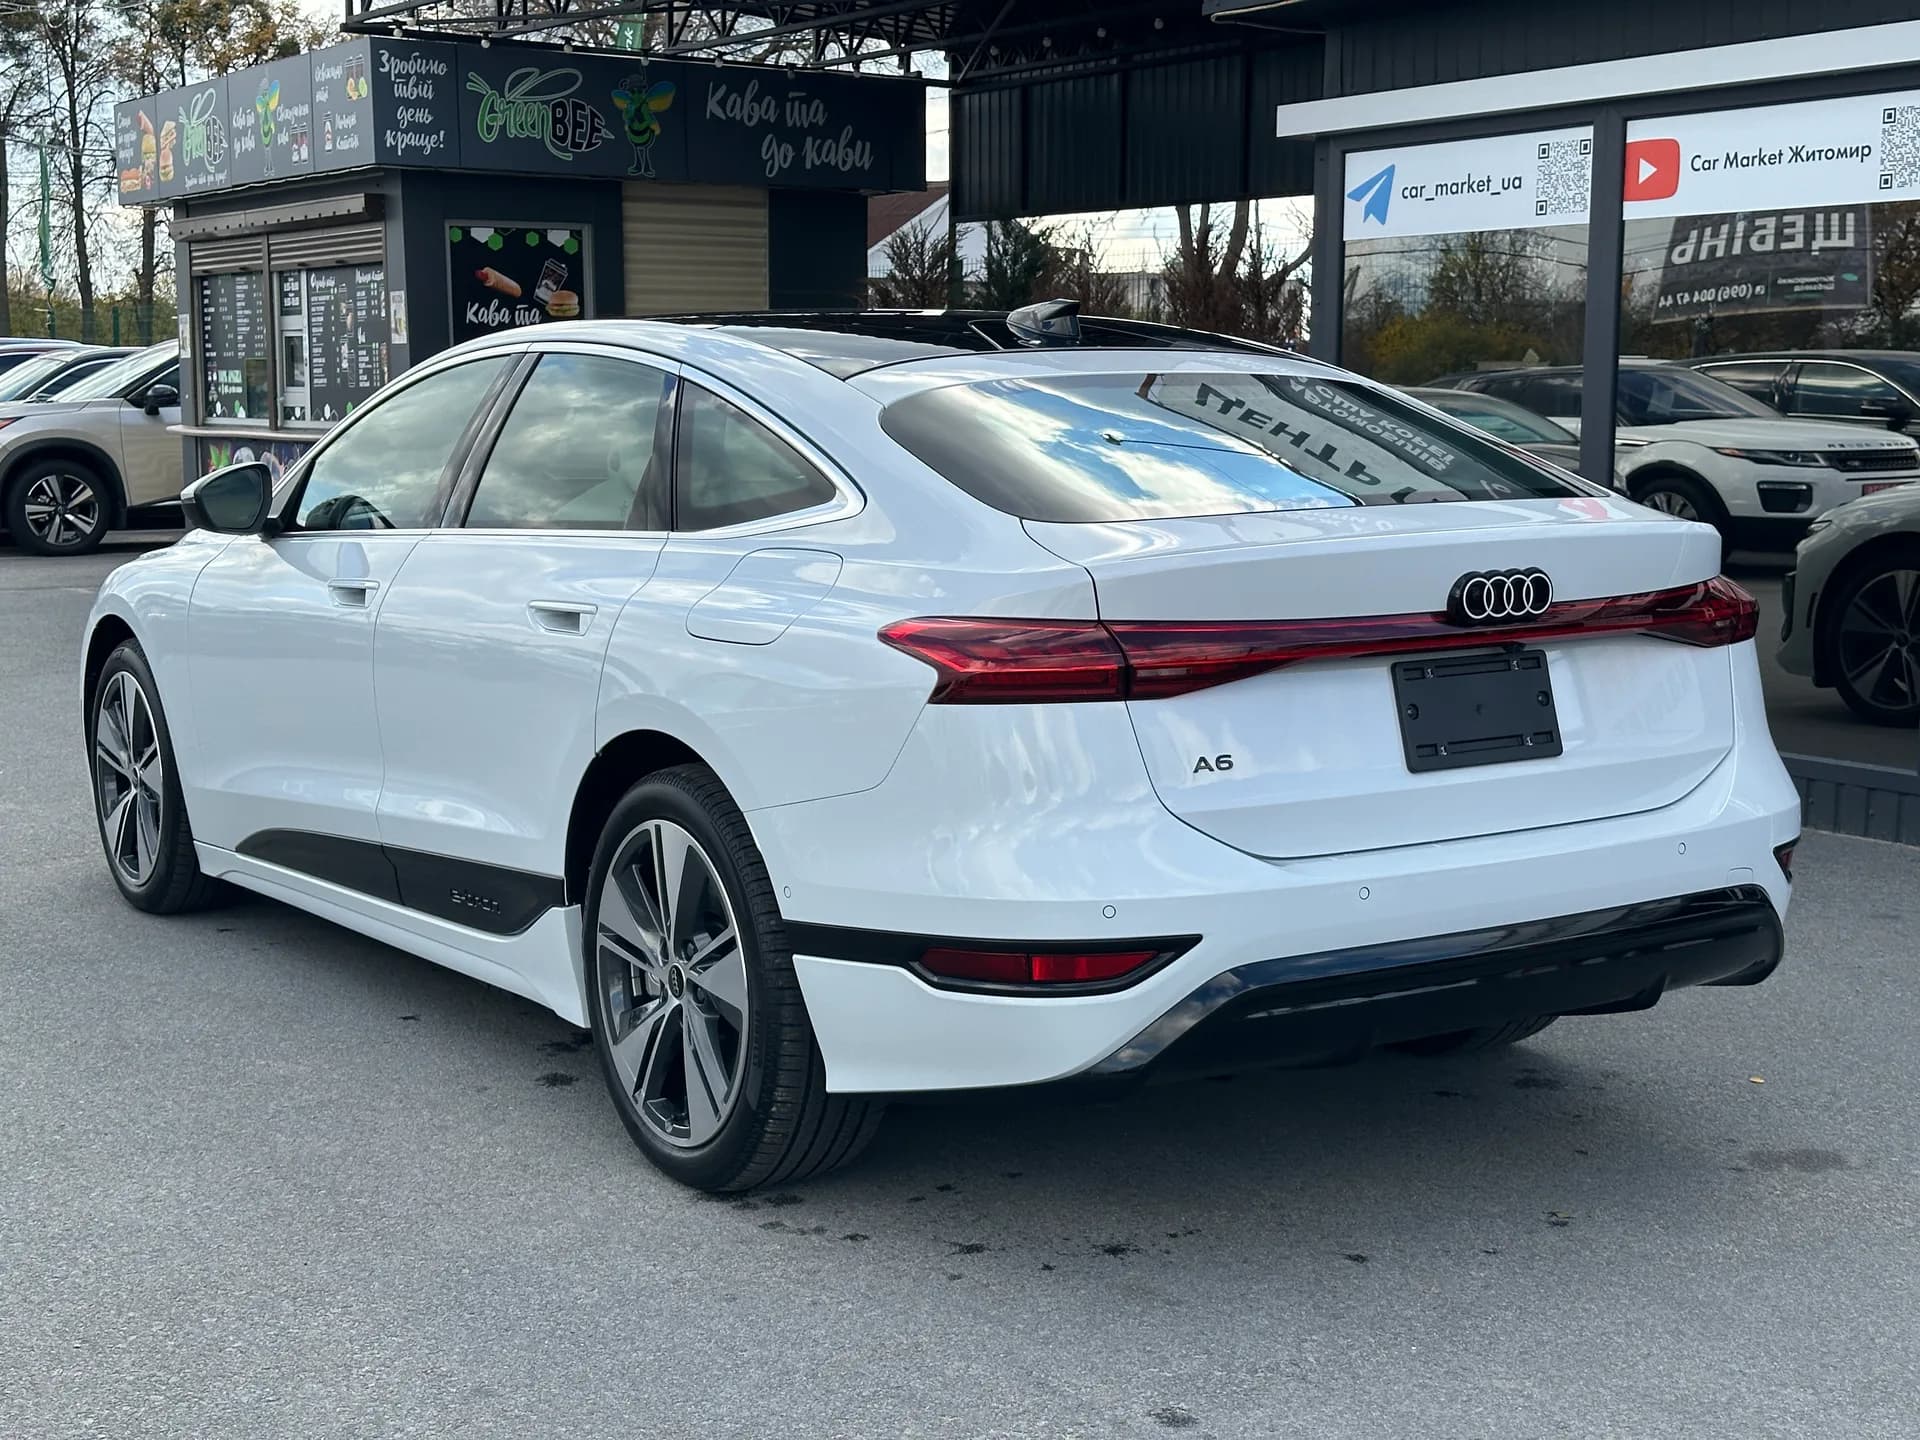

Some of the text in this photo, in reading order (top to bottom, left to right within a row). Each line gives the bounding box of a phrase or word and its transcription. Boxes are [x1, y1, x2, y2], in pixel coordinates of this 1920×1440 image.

[379, 49, 448, 79] Зробимо
[394, 79, 435, 100] твій
[705, 79, 828, 128] Кава та
[397, 106, 434, 126] день
[477, 93, 605, 158] GreenBEE
[385, 127, 445, 156] краще!
[762, 126, 874, 178] до кави
[1690, 142, 1873, 173] Car Market Житомир
[1401, 173, 1523, 202] car_market_ua
[465, 299, 542, 326] Кава та
[1193, 754, 1234, 773] A6
